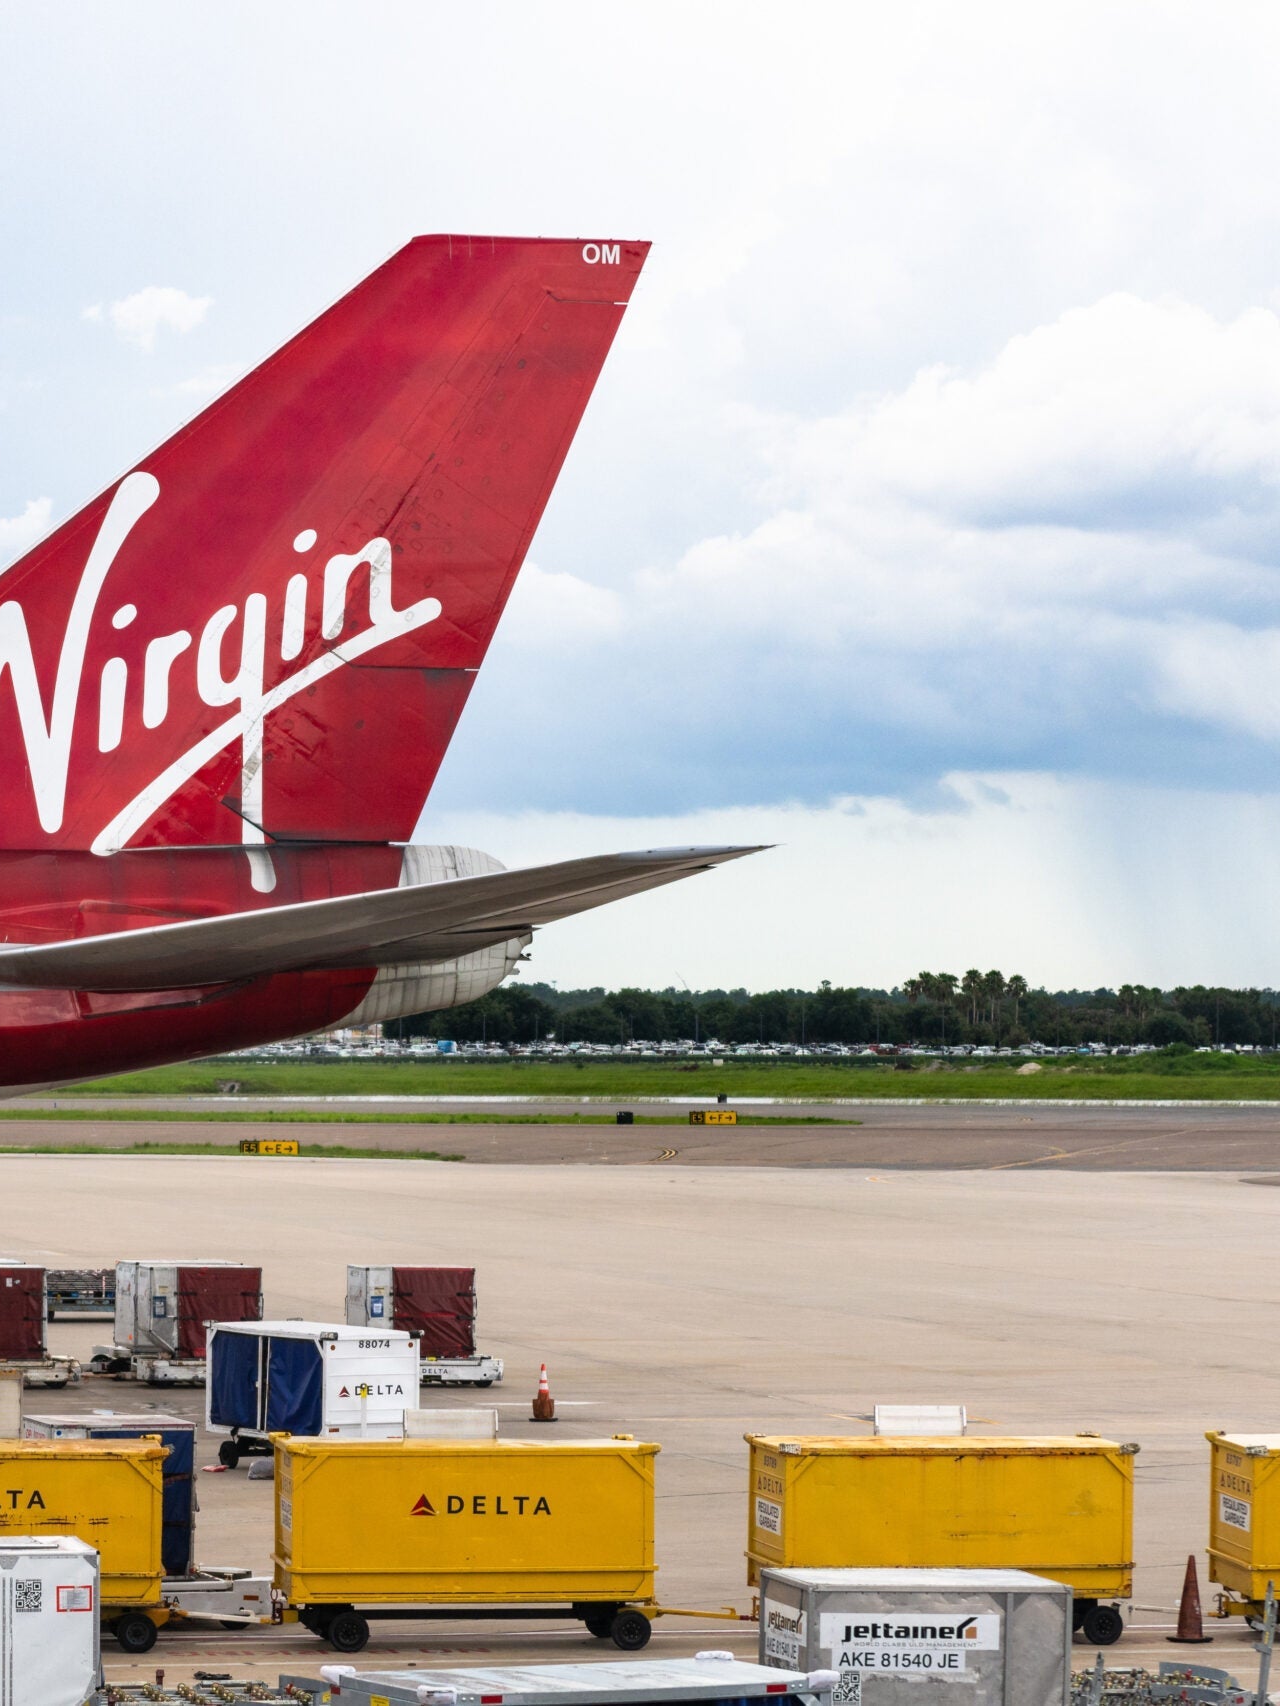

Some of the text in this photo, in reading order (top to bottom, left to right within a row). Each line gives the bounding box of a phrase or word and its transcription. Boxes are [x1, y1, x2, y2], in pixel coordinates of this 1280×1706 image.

[582, 243, 621, 265] OM
[243, 1143, 282, 1154] E5 E
[358, 1340, 390, 1349] 88074
[763, 1476, 783, 1496] DELTA
[1227, 1474, 1251, 1496] DELTA
[447, 1495, 552, 1515] DELTA
[768, 1611, 803, 1634] jettainer
[841, 1617, 979, 1643] jettainer
[166, 1648, 400, 1657] PRKING
[838, 1652, 959, 1668] AKE 81540 JE
